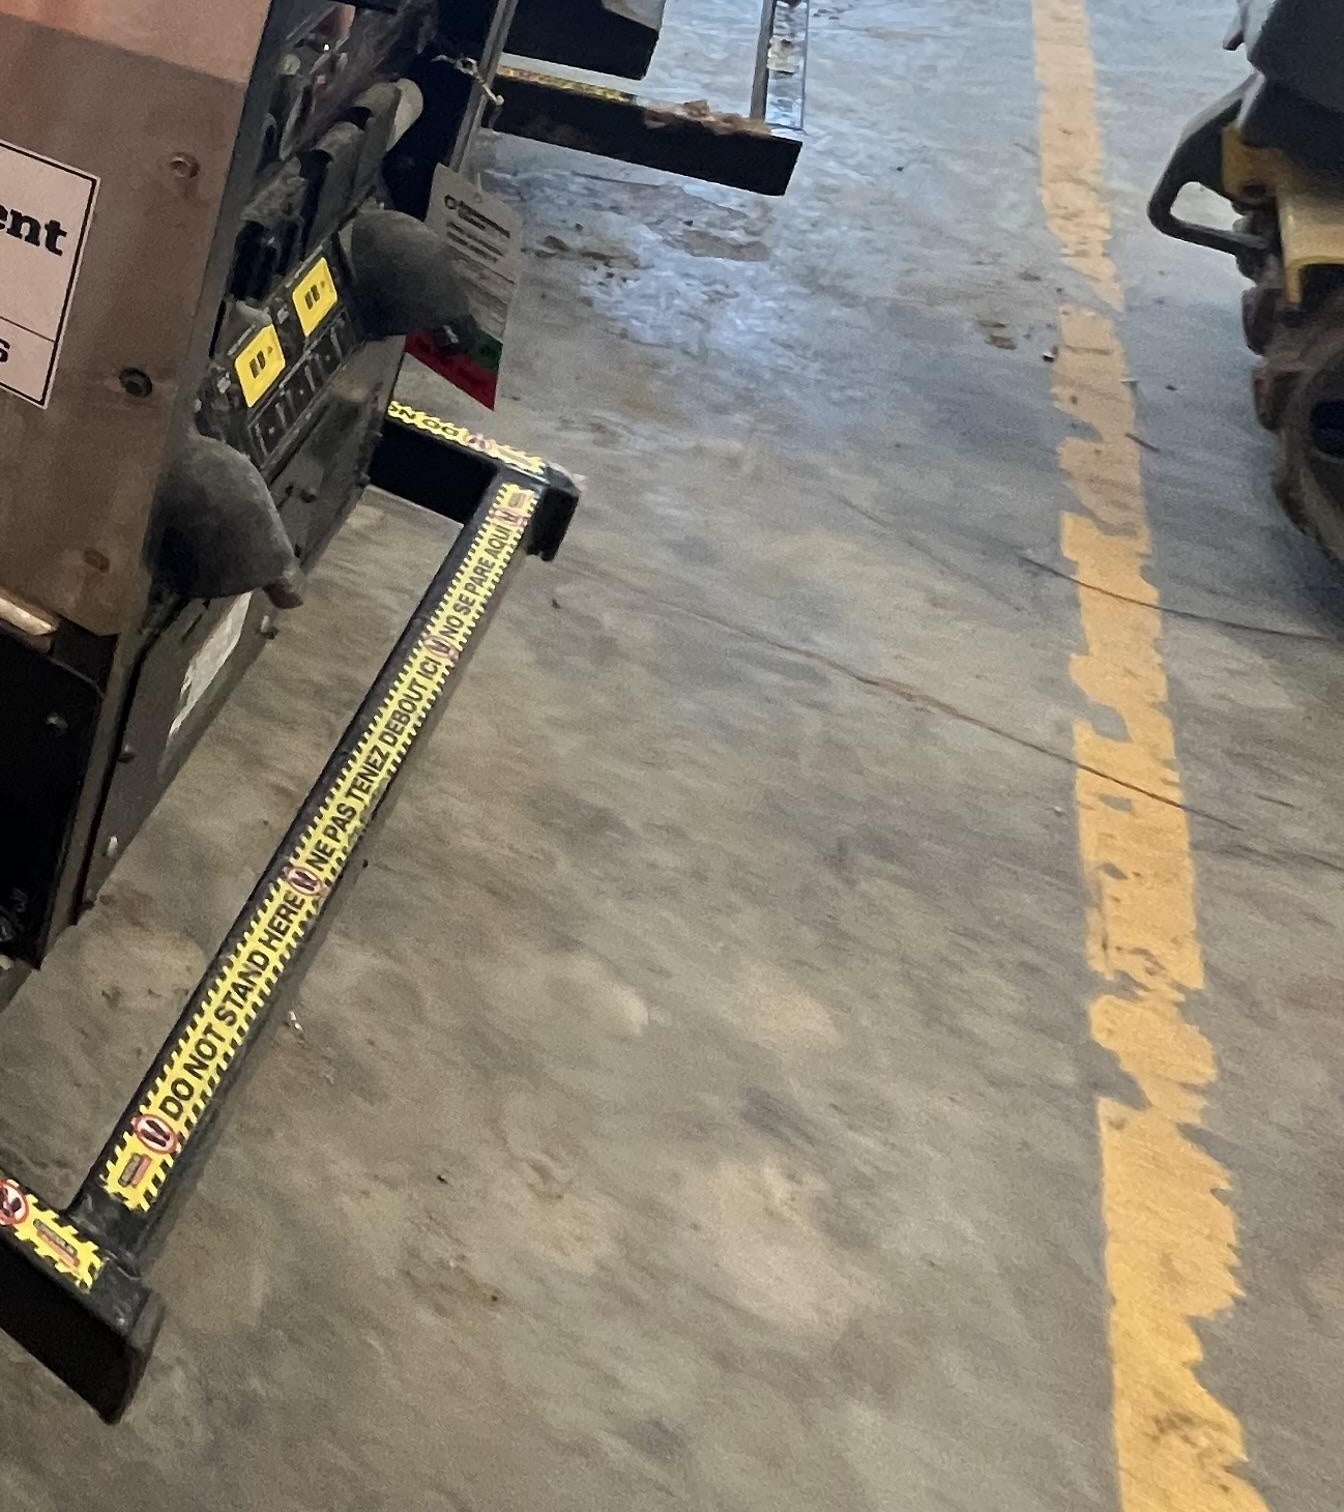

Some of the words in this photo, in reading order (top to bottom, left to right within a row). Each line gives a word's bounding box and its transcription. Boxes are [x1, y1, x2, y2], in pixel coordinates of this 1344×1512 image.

[464, 556, 496, 596] PARE
[453, 593, 477, 617] SE
[438, 615, 464, 642] NO
[416, 656, 442, 682] ICI
[378, 678, 427, 747] DEBOUT
[345, 744, 391, 803] TENEZ
[322, 801, 357, 845] PAS
[305, 839, 336, 872] NE
[258, 890, 306, 953] HERE
[213, 949, 270, 1027] STAND
[183, 1022, 226, 1081] NOT
[159, 1077, 195, 1121] DO
